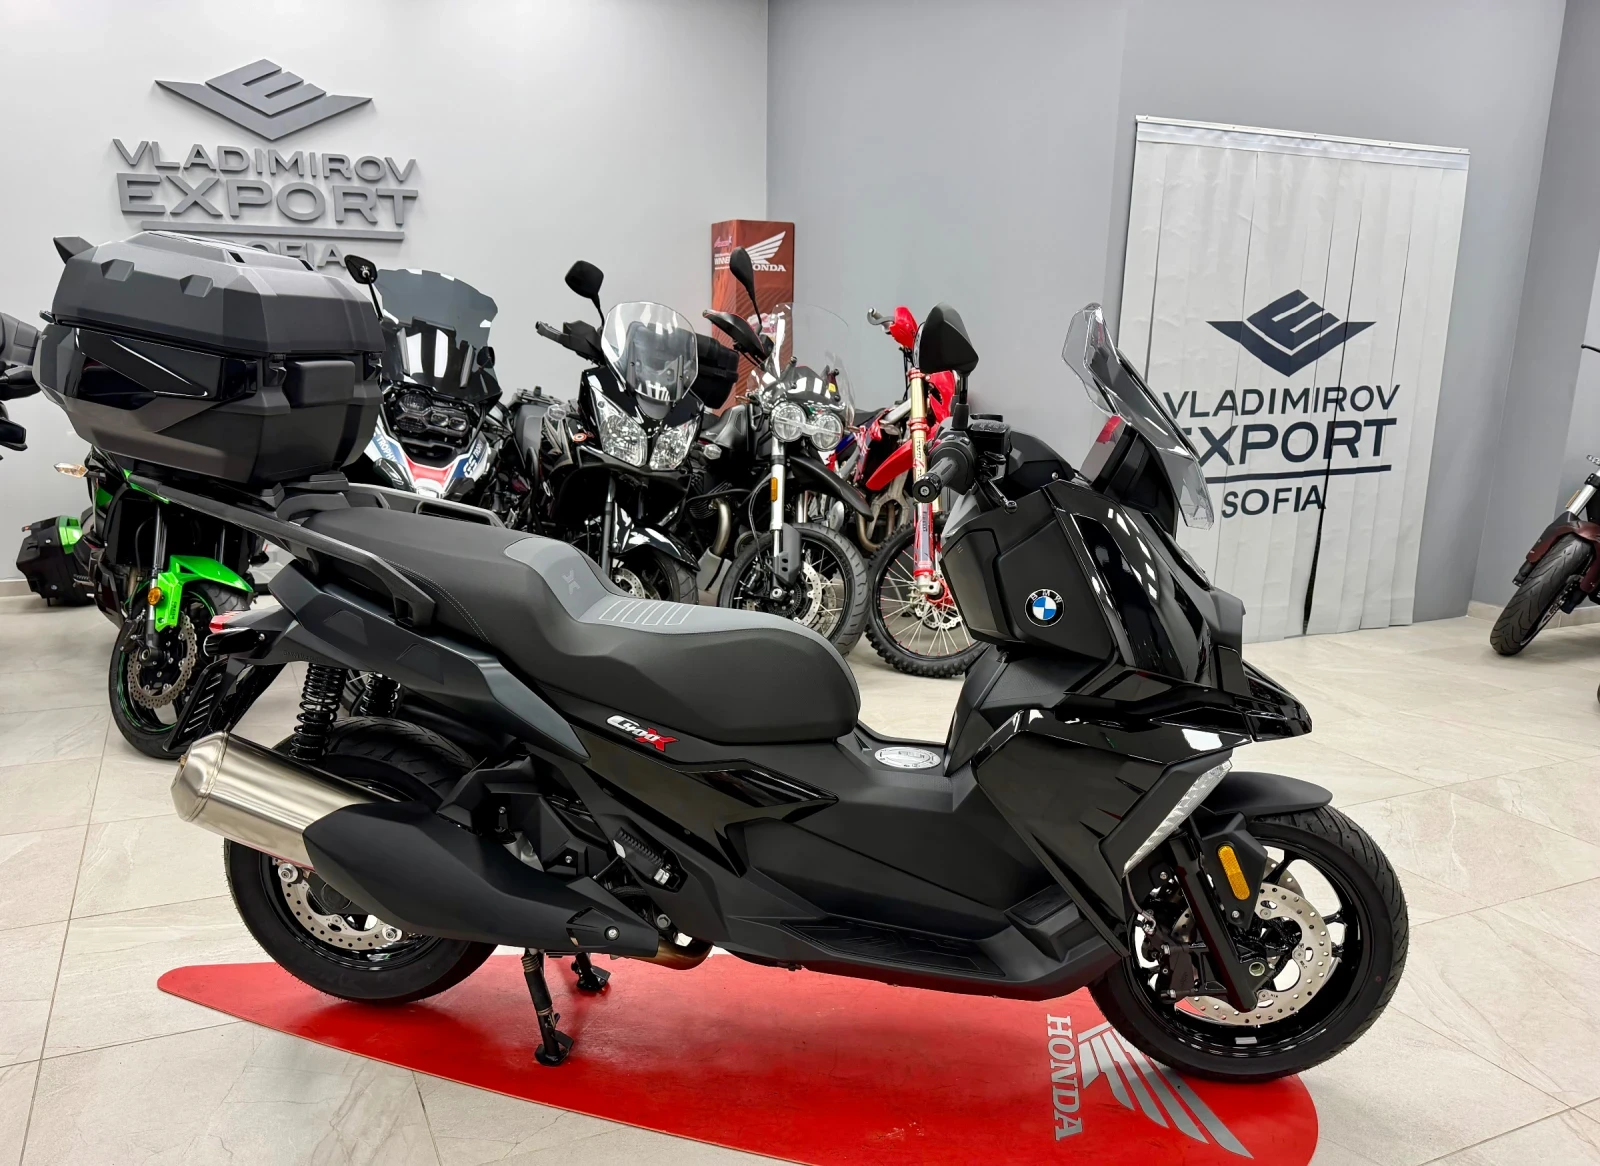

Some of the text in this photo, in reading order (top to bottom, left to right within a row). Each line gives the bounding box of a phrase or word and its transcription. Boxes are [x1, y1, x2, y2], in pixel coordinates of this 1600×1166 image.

[113, 138, 416, 183] VLADIMIROV
[116, 172, 418, 226] EXPORT
[228, 240, 347, 268] FIA
[752, 263, 787, 272] ONDA
[1163, 384, 1400, 419] VLADIMIROV
[377, 437, 398, 463] TROPHY
[1183, 418, 1397, 467] XPORT
[1221, 485, 1326, 519] SOFIA
[1046, 1013, 1083, 1141] HONDA
